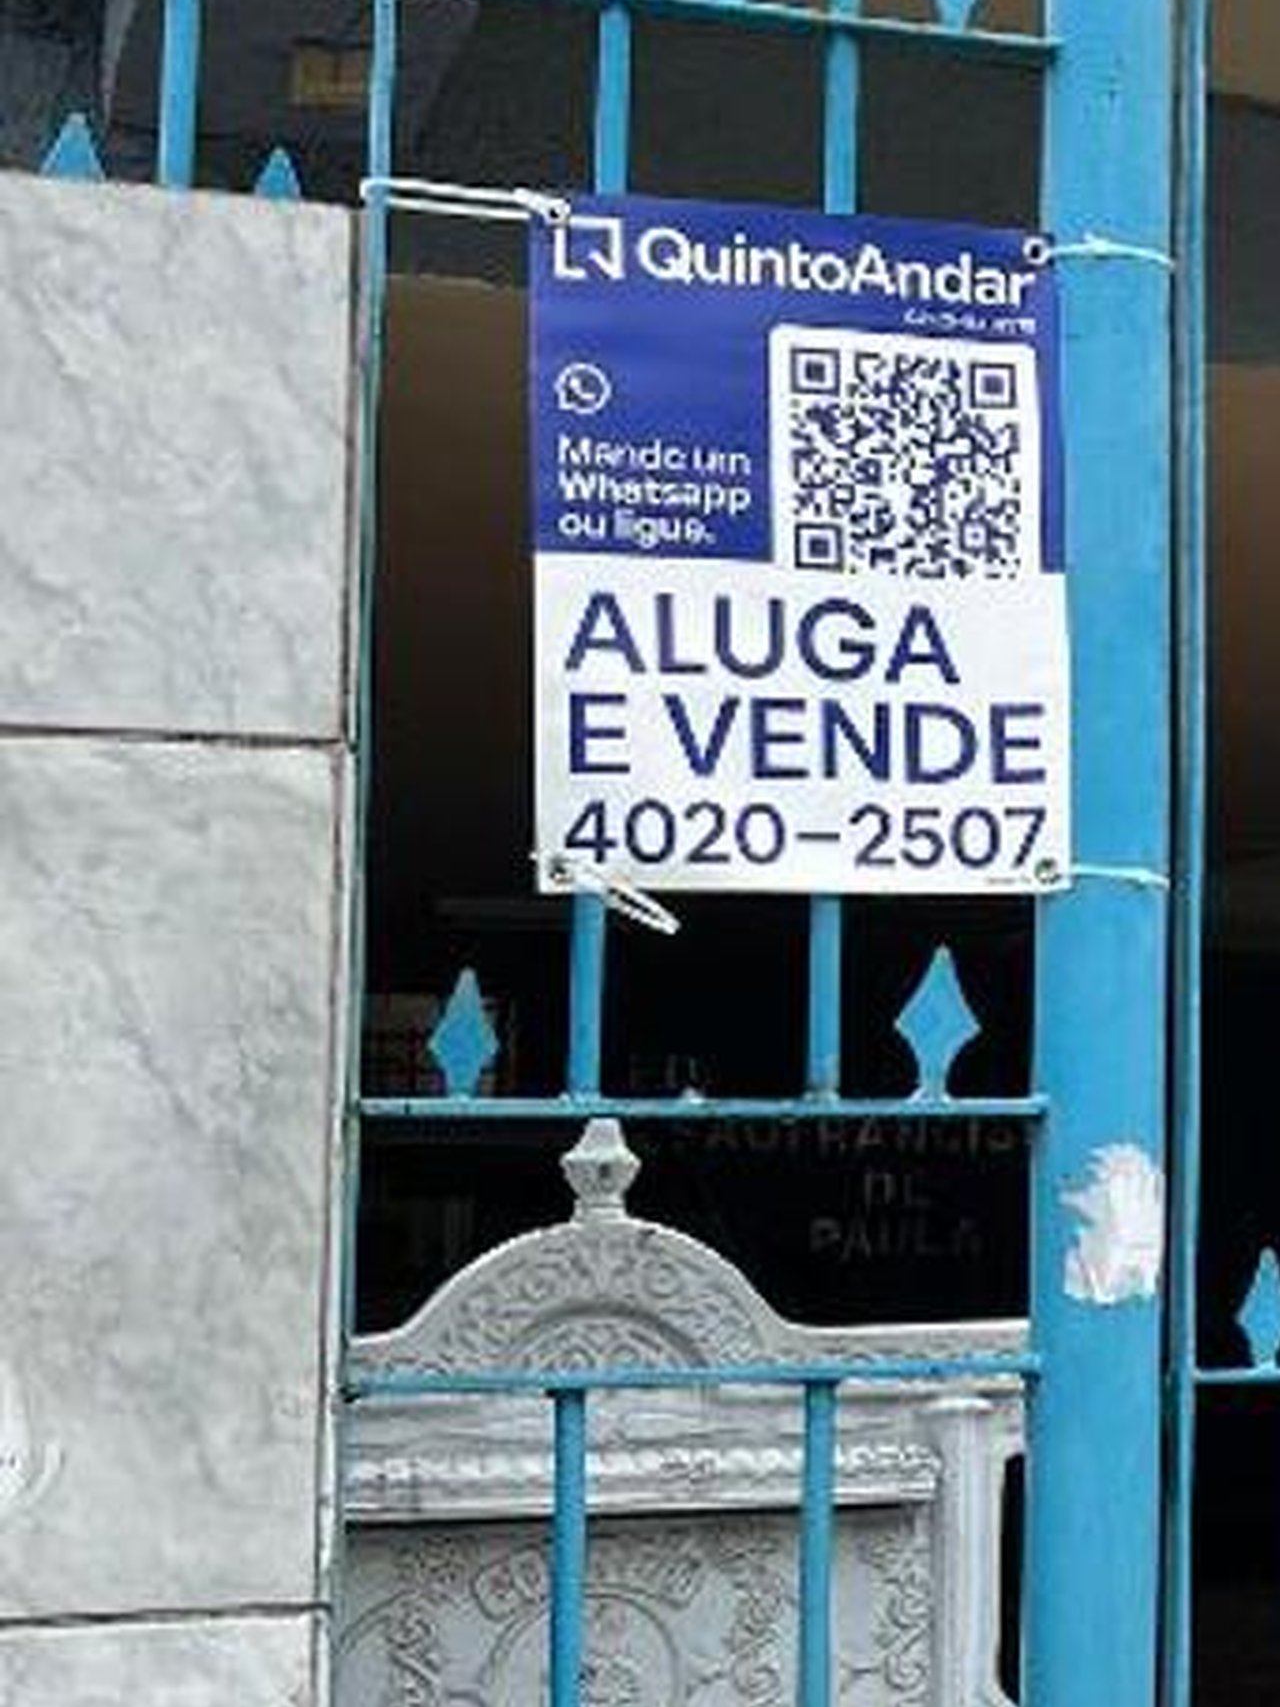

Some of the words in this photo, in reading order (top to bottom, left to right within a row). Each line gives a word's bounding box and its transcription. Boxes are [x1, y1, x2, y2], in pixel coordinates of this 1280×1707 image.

[637, 226, 1036, 307] QuintoAndar
[558, 513, 606, 540] ou
[564, 592, 961, 685] ALUGA
[568, 693, 632, 774] E
[662, 693, 1046, 784] VENDE
[564, 796, 1047, 869] 4020-2507
